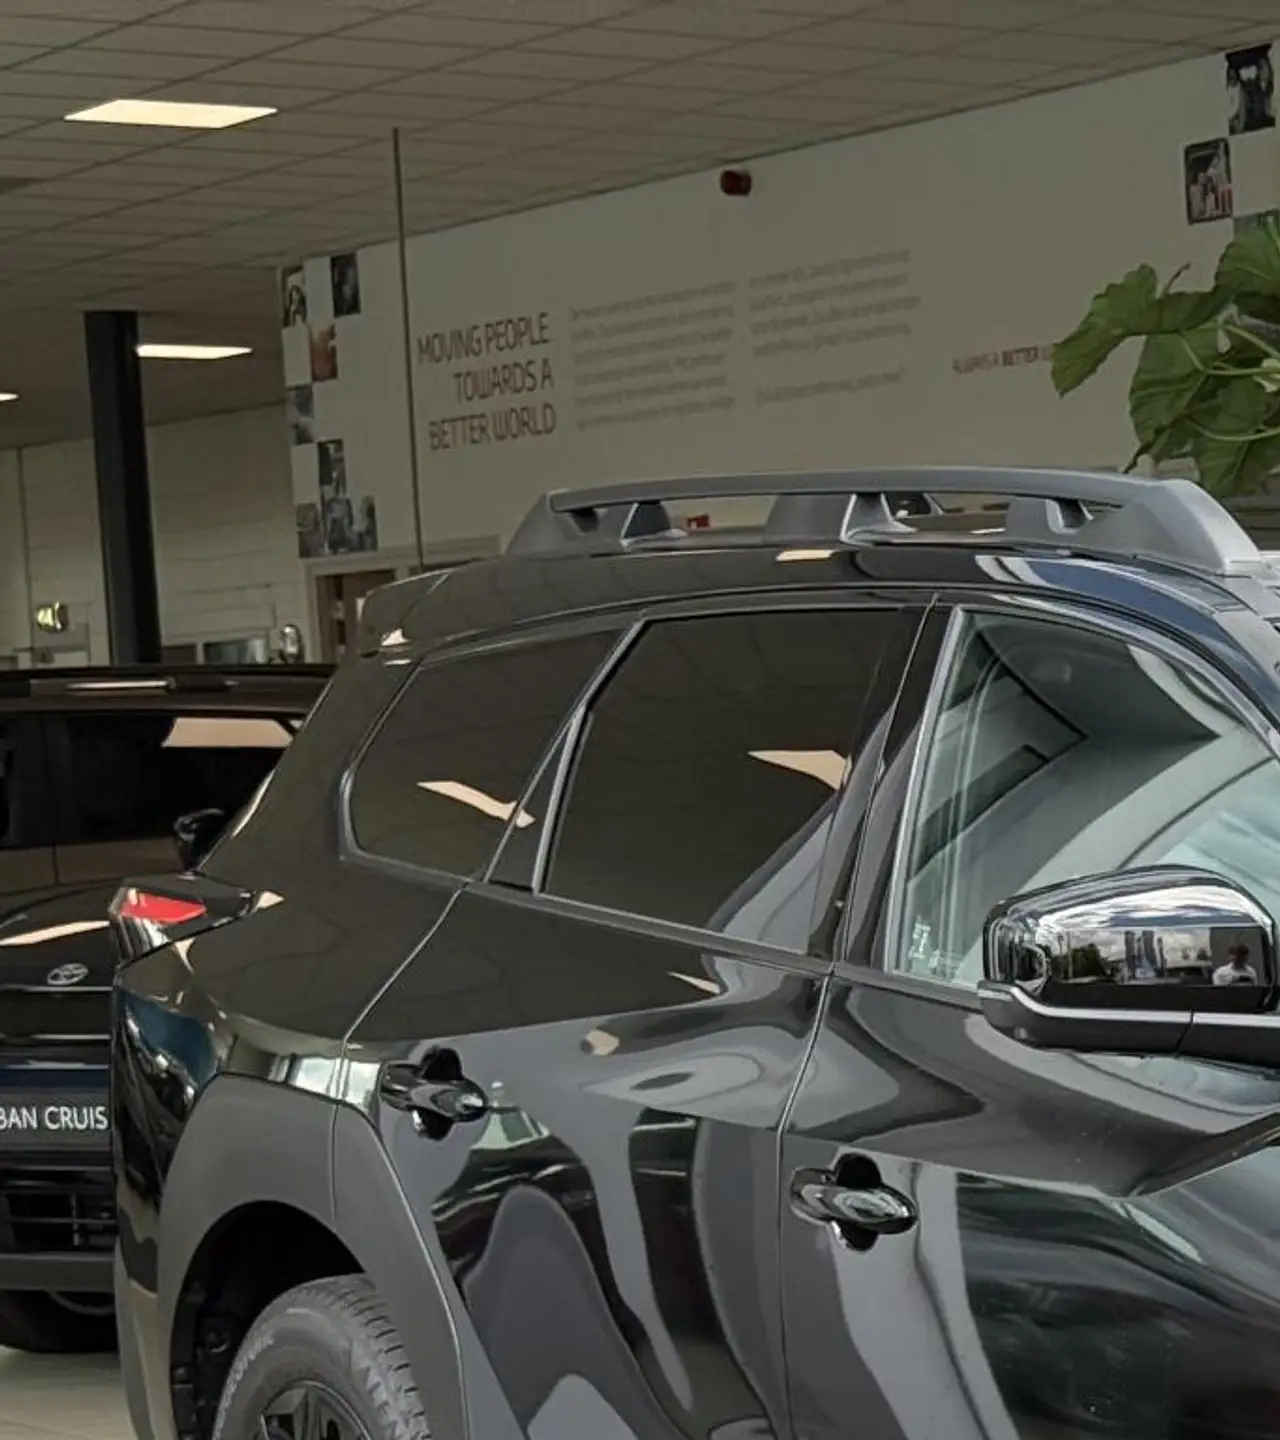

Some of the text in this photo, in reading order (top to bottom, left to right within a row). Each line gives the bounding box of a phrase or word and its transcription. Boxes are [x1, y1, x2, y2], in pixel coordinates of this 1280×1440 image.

[417, 311, 550, 365] MOVING PEOPLE
[454, 358, 555, 404] TOWARDS A
[429, 402, 557, 451] BETTER WORLD
[45, 1105, 109, 1130] CRUIS
